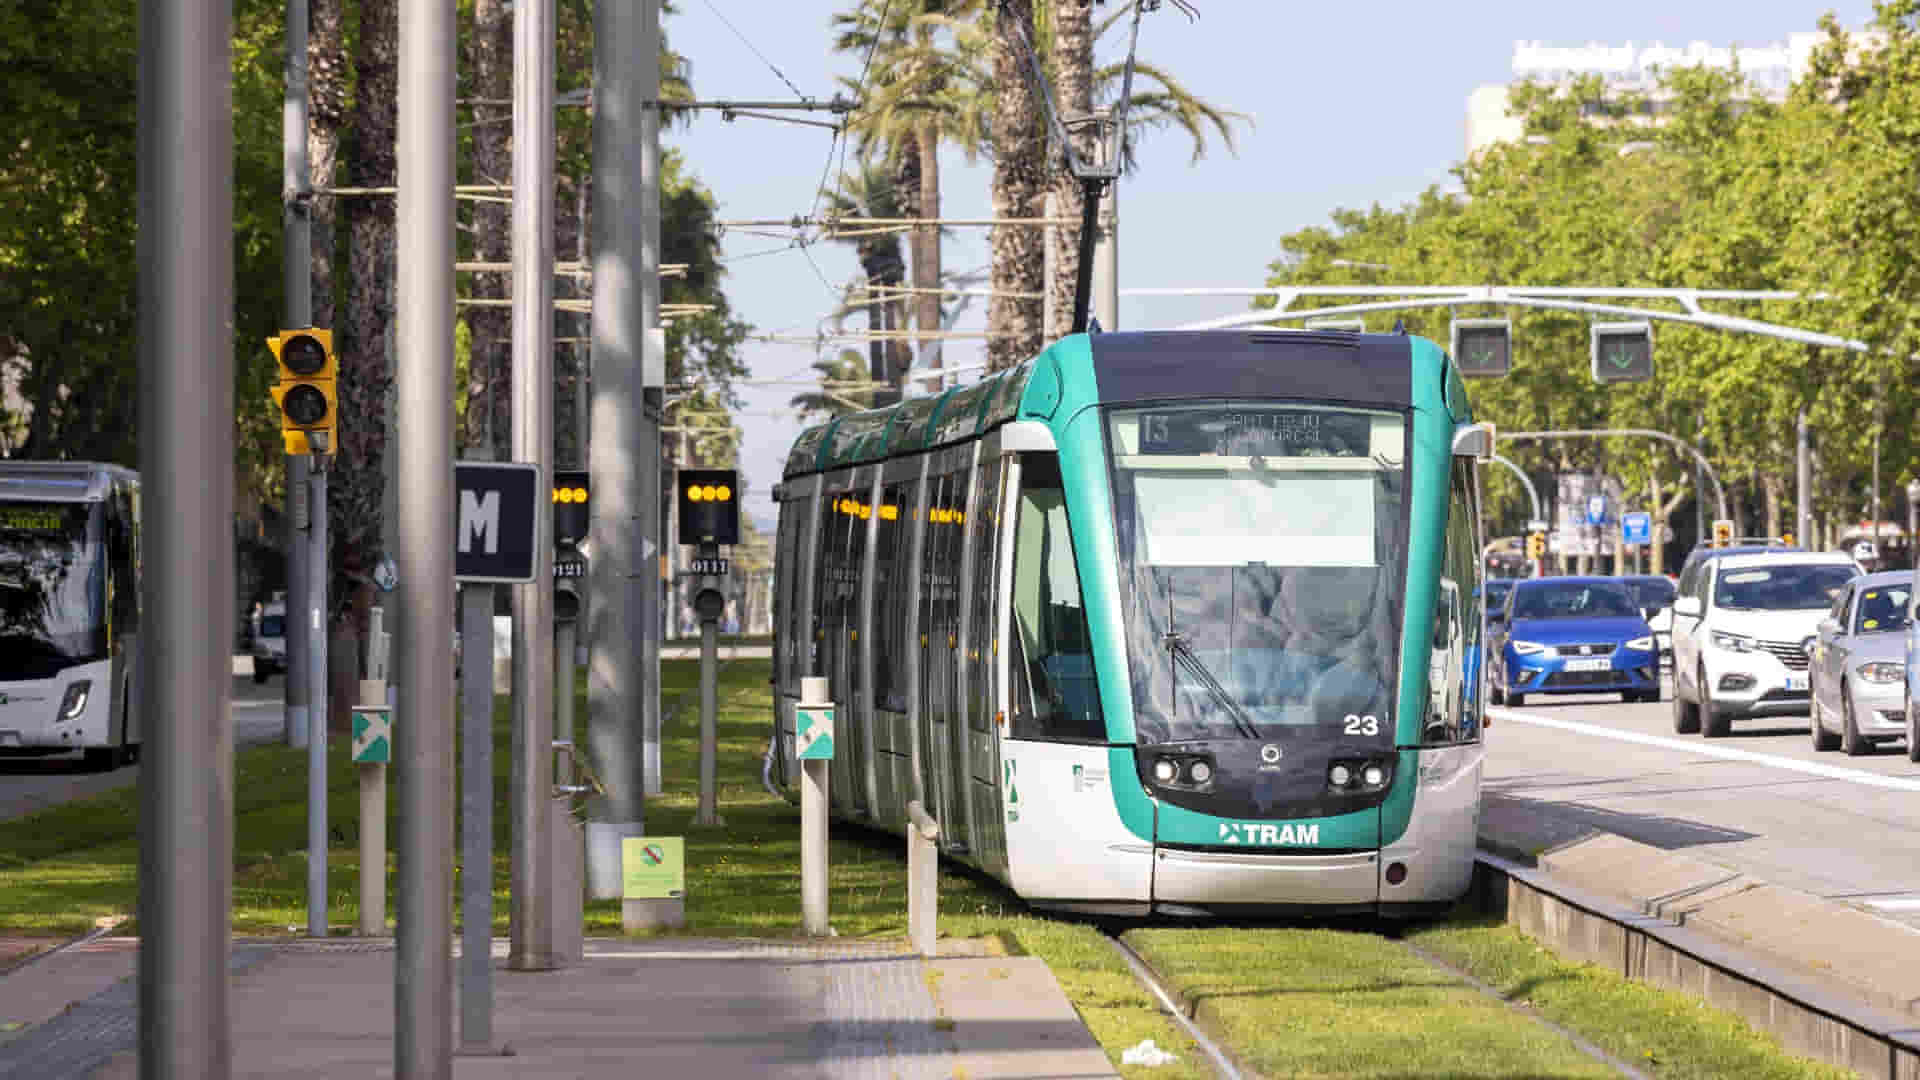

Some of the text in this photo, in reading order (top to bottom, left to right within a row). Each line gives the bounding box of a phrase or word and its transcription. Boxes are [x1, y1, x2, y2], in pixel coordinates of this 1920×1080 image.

[458, 489, 500, 553] M
[1344, 714, 1379, 736] 23
[1243, 824, 1320, 844] TRAM
